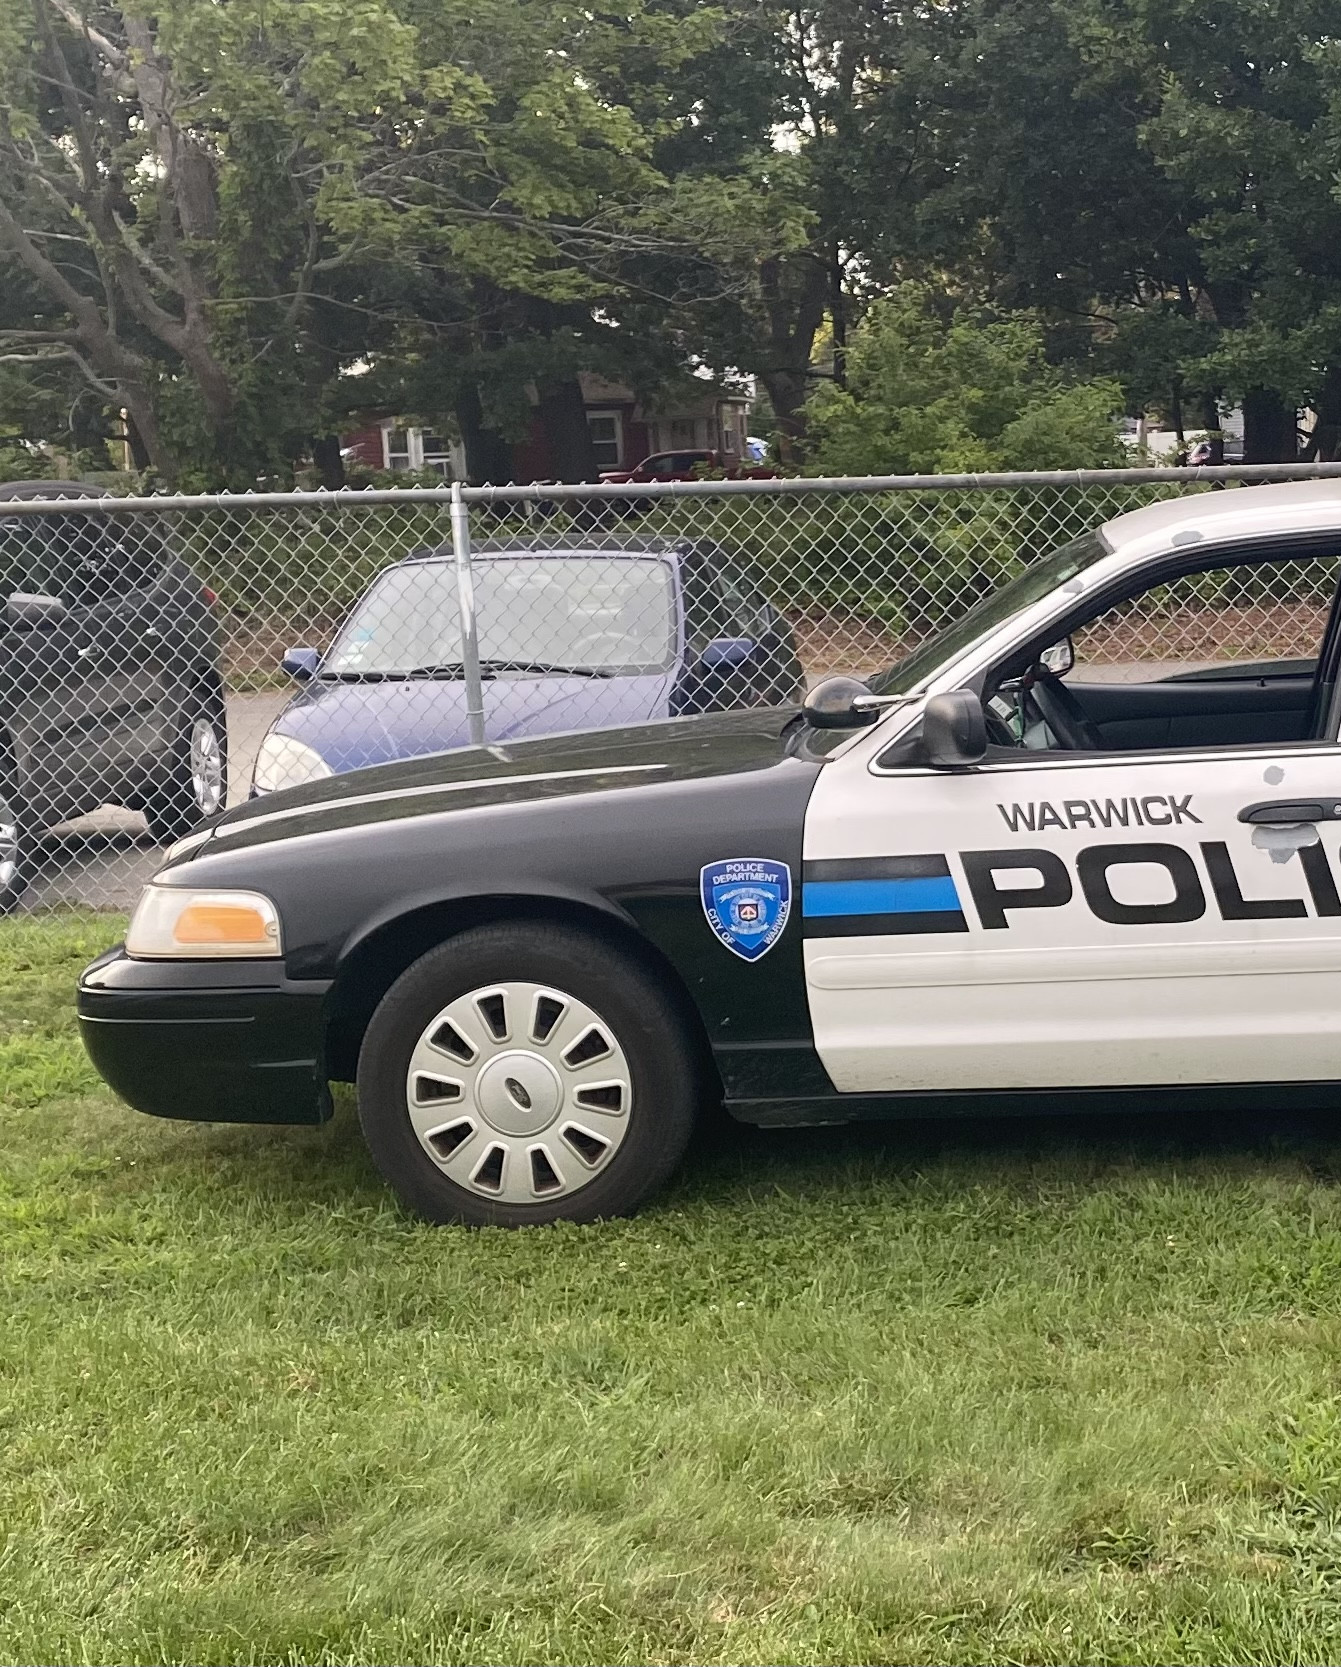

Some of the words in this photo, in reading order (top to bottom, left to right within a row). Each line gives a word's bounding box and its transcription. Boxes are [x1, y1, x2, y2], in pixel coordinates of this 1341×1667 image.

[997, 794, 1203, 832] WARWICK
[712, 872, 779, 885] DEPARTMENT
[726, 863, 764, 872] POLICE
[708, 909, 723, 931] CITY
[721, 932, 736, 945] OF
[764, 900, 788, 944] WARWICK
